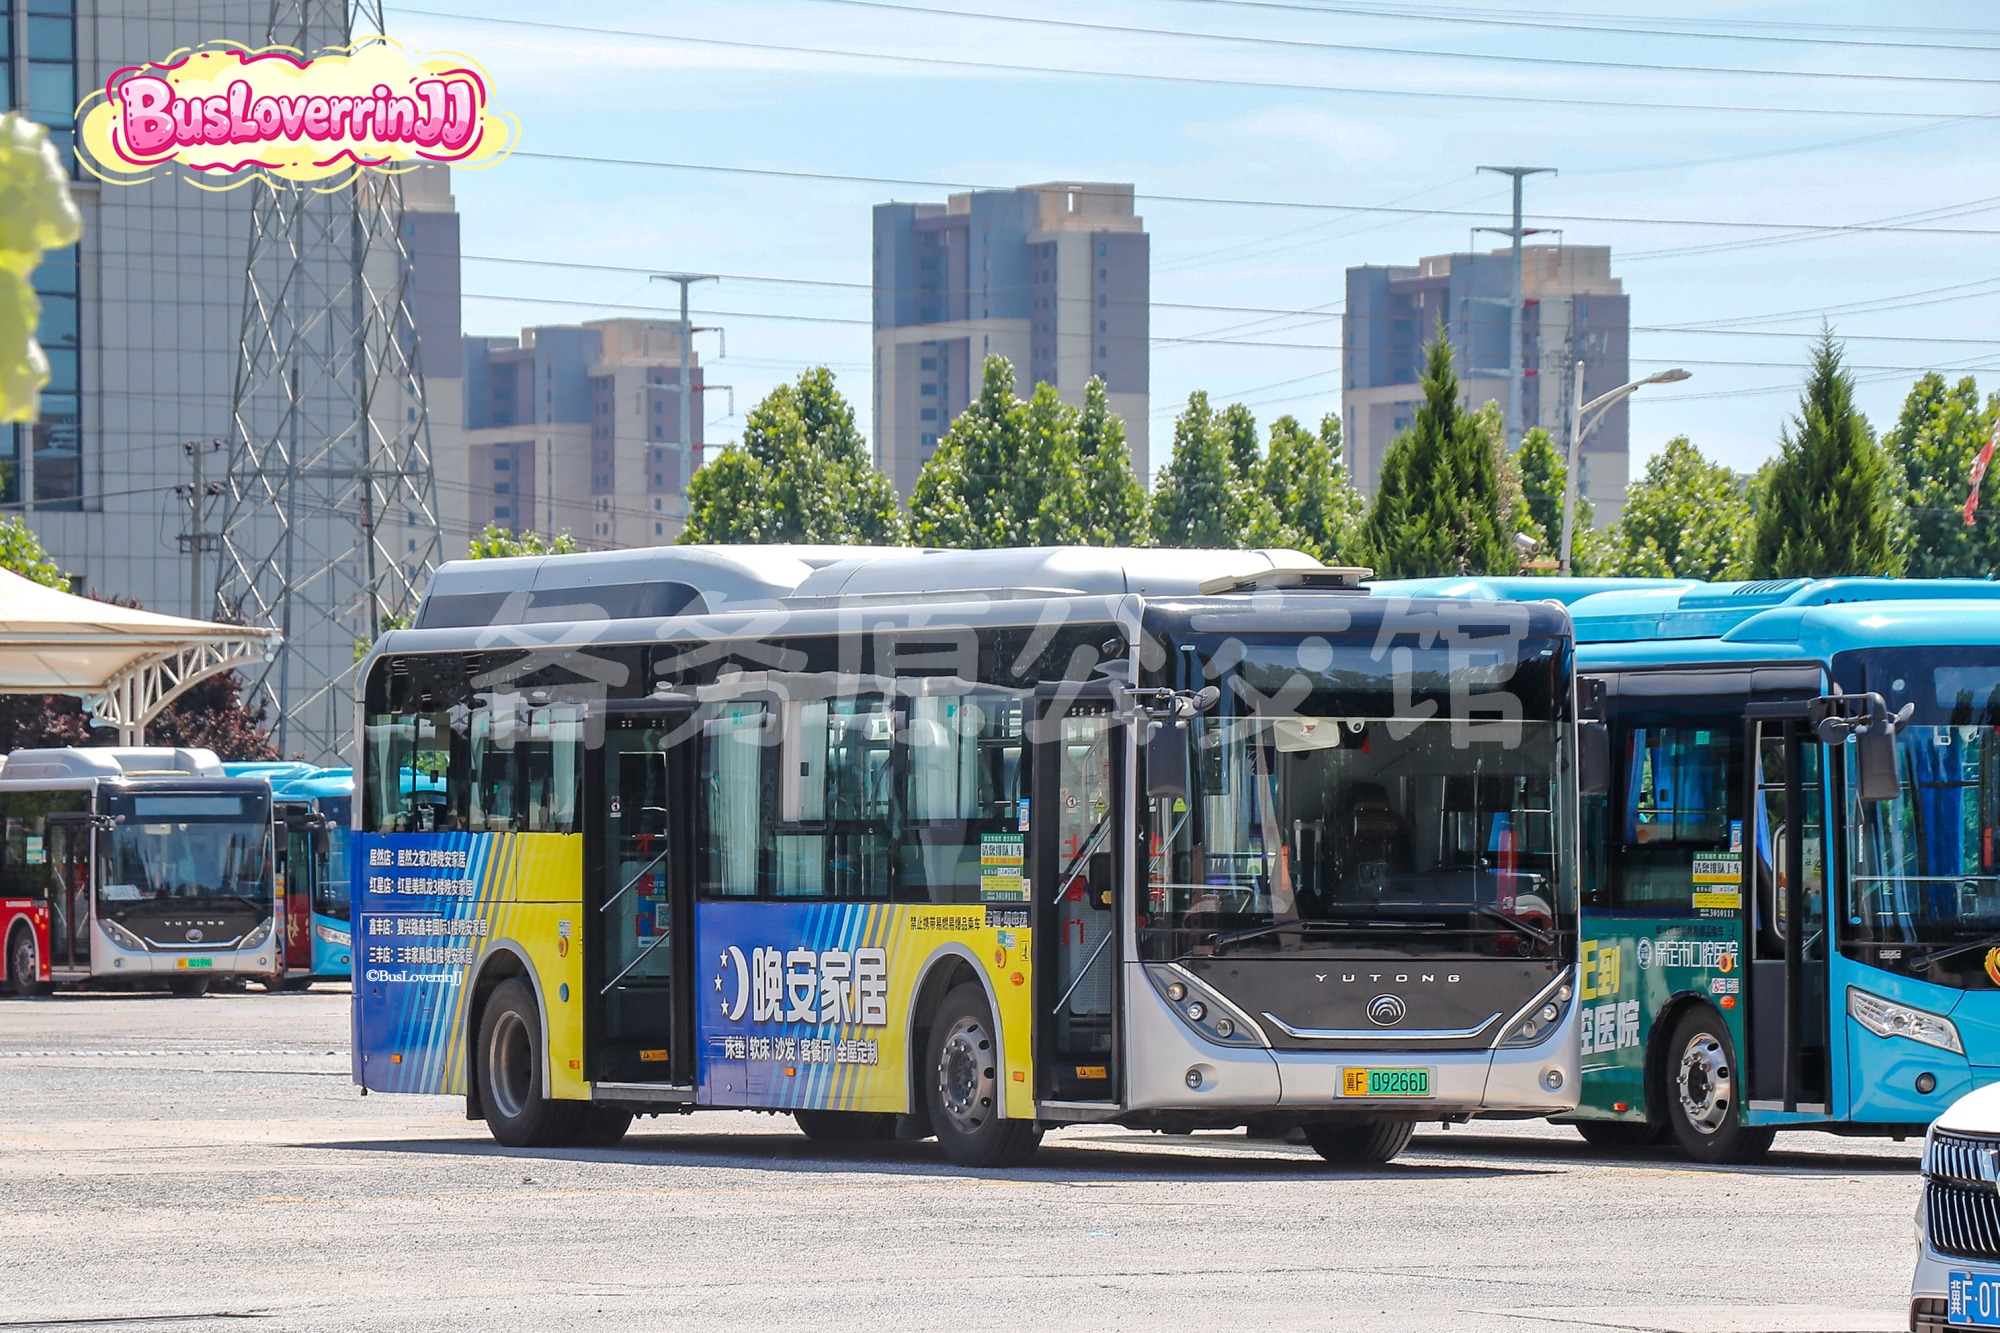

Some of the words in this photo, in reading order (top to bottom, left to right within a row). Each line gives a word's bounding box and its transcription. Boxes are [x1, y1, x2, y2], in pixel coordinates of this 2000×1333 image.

[1654, 940, 1739, 968] 保定市口腔医院
[752, 946, 888, 1026] 晚安家居
[1315, 973, 1461, 983] YUTONG
[1372, 1071, 1428, 1092] 09266D
